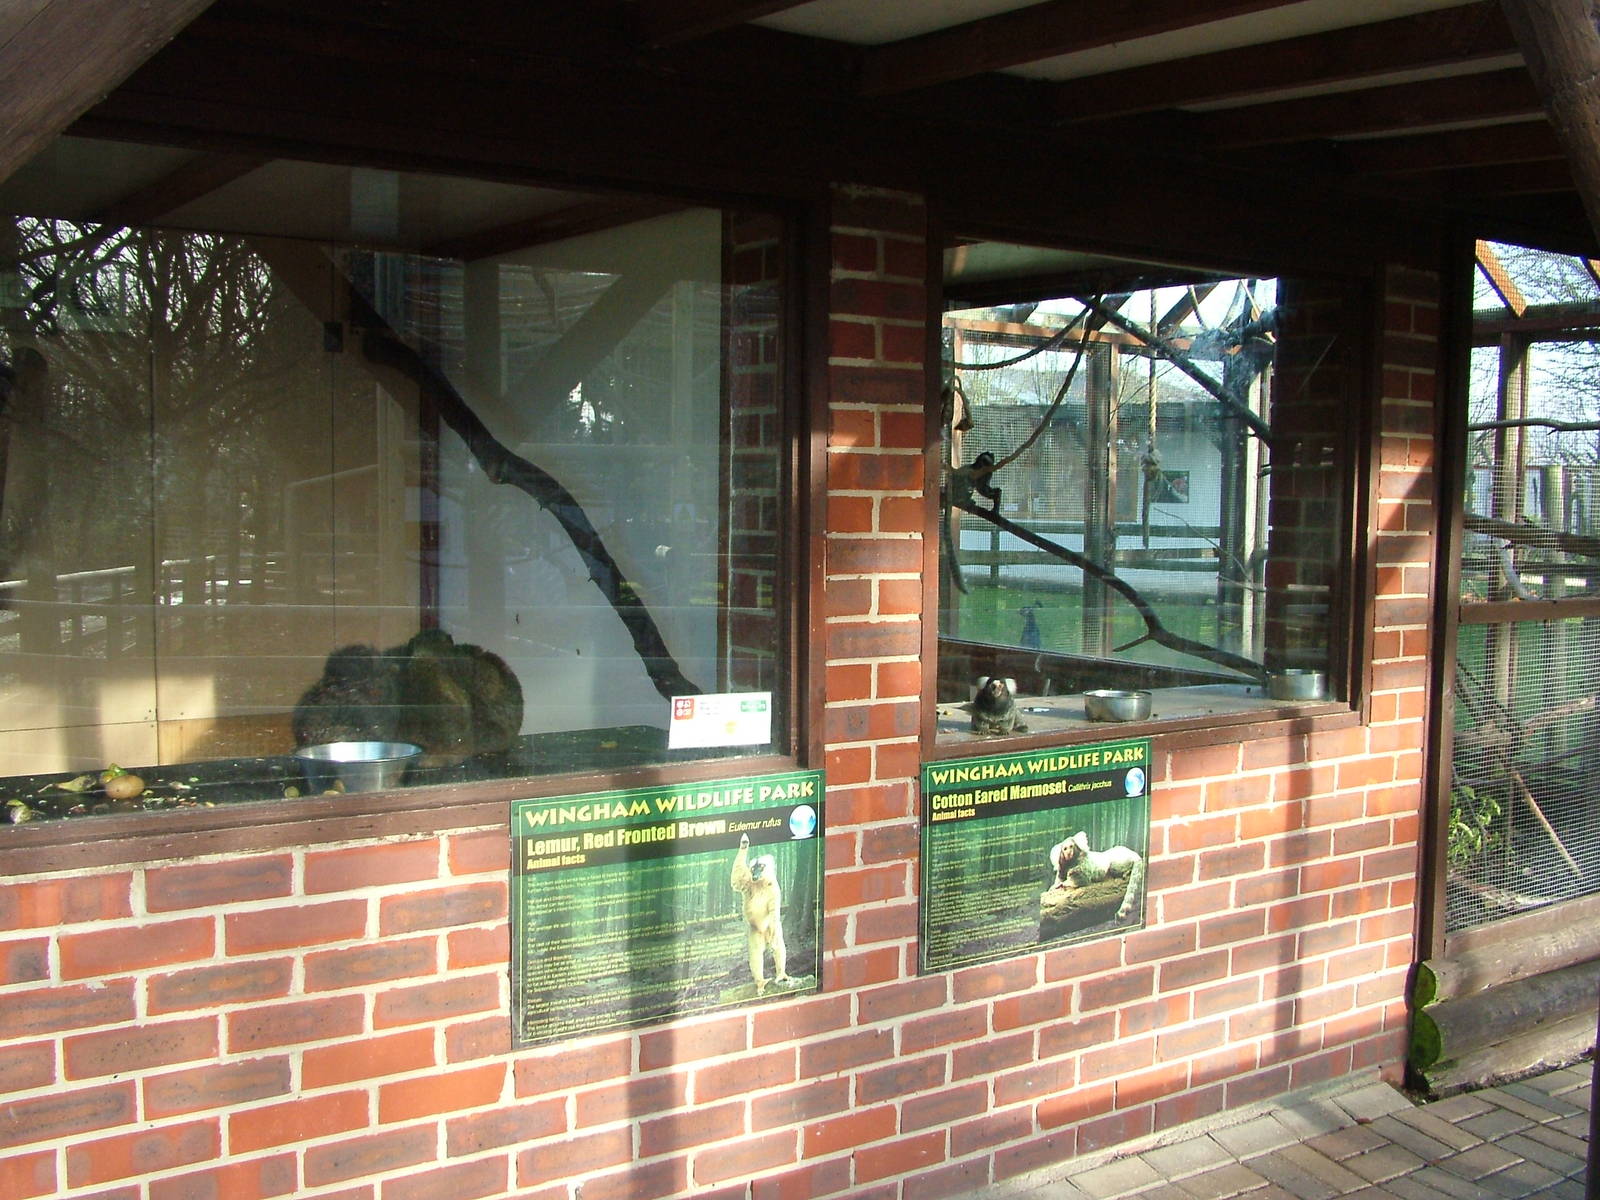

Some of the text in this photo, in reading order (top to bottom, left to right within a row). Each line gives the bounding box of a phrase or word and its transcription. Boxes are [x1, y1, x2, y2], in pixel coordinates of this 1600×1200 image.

[931, 746, 1144, 786] WINGHAM WILDLIFE PARK
[526, 780, 815, 828] WINGHAM WILDLIFE PARK
[932, 793, 973, 811] Cotton
[974, 787, 1008, 806] Eared
[1010, 780, 1067, 800] Marmoset
[932, 808, 976, 822] Animal facts
[527, 816, 782, 857] Lemur, Red Fronted Brown Eulemur rufus
[527, 853, 586, 870] Animal facts
